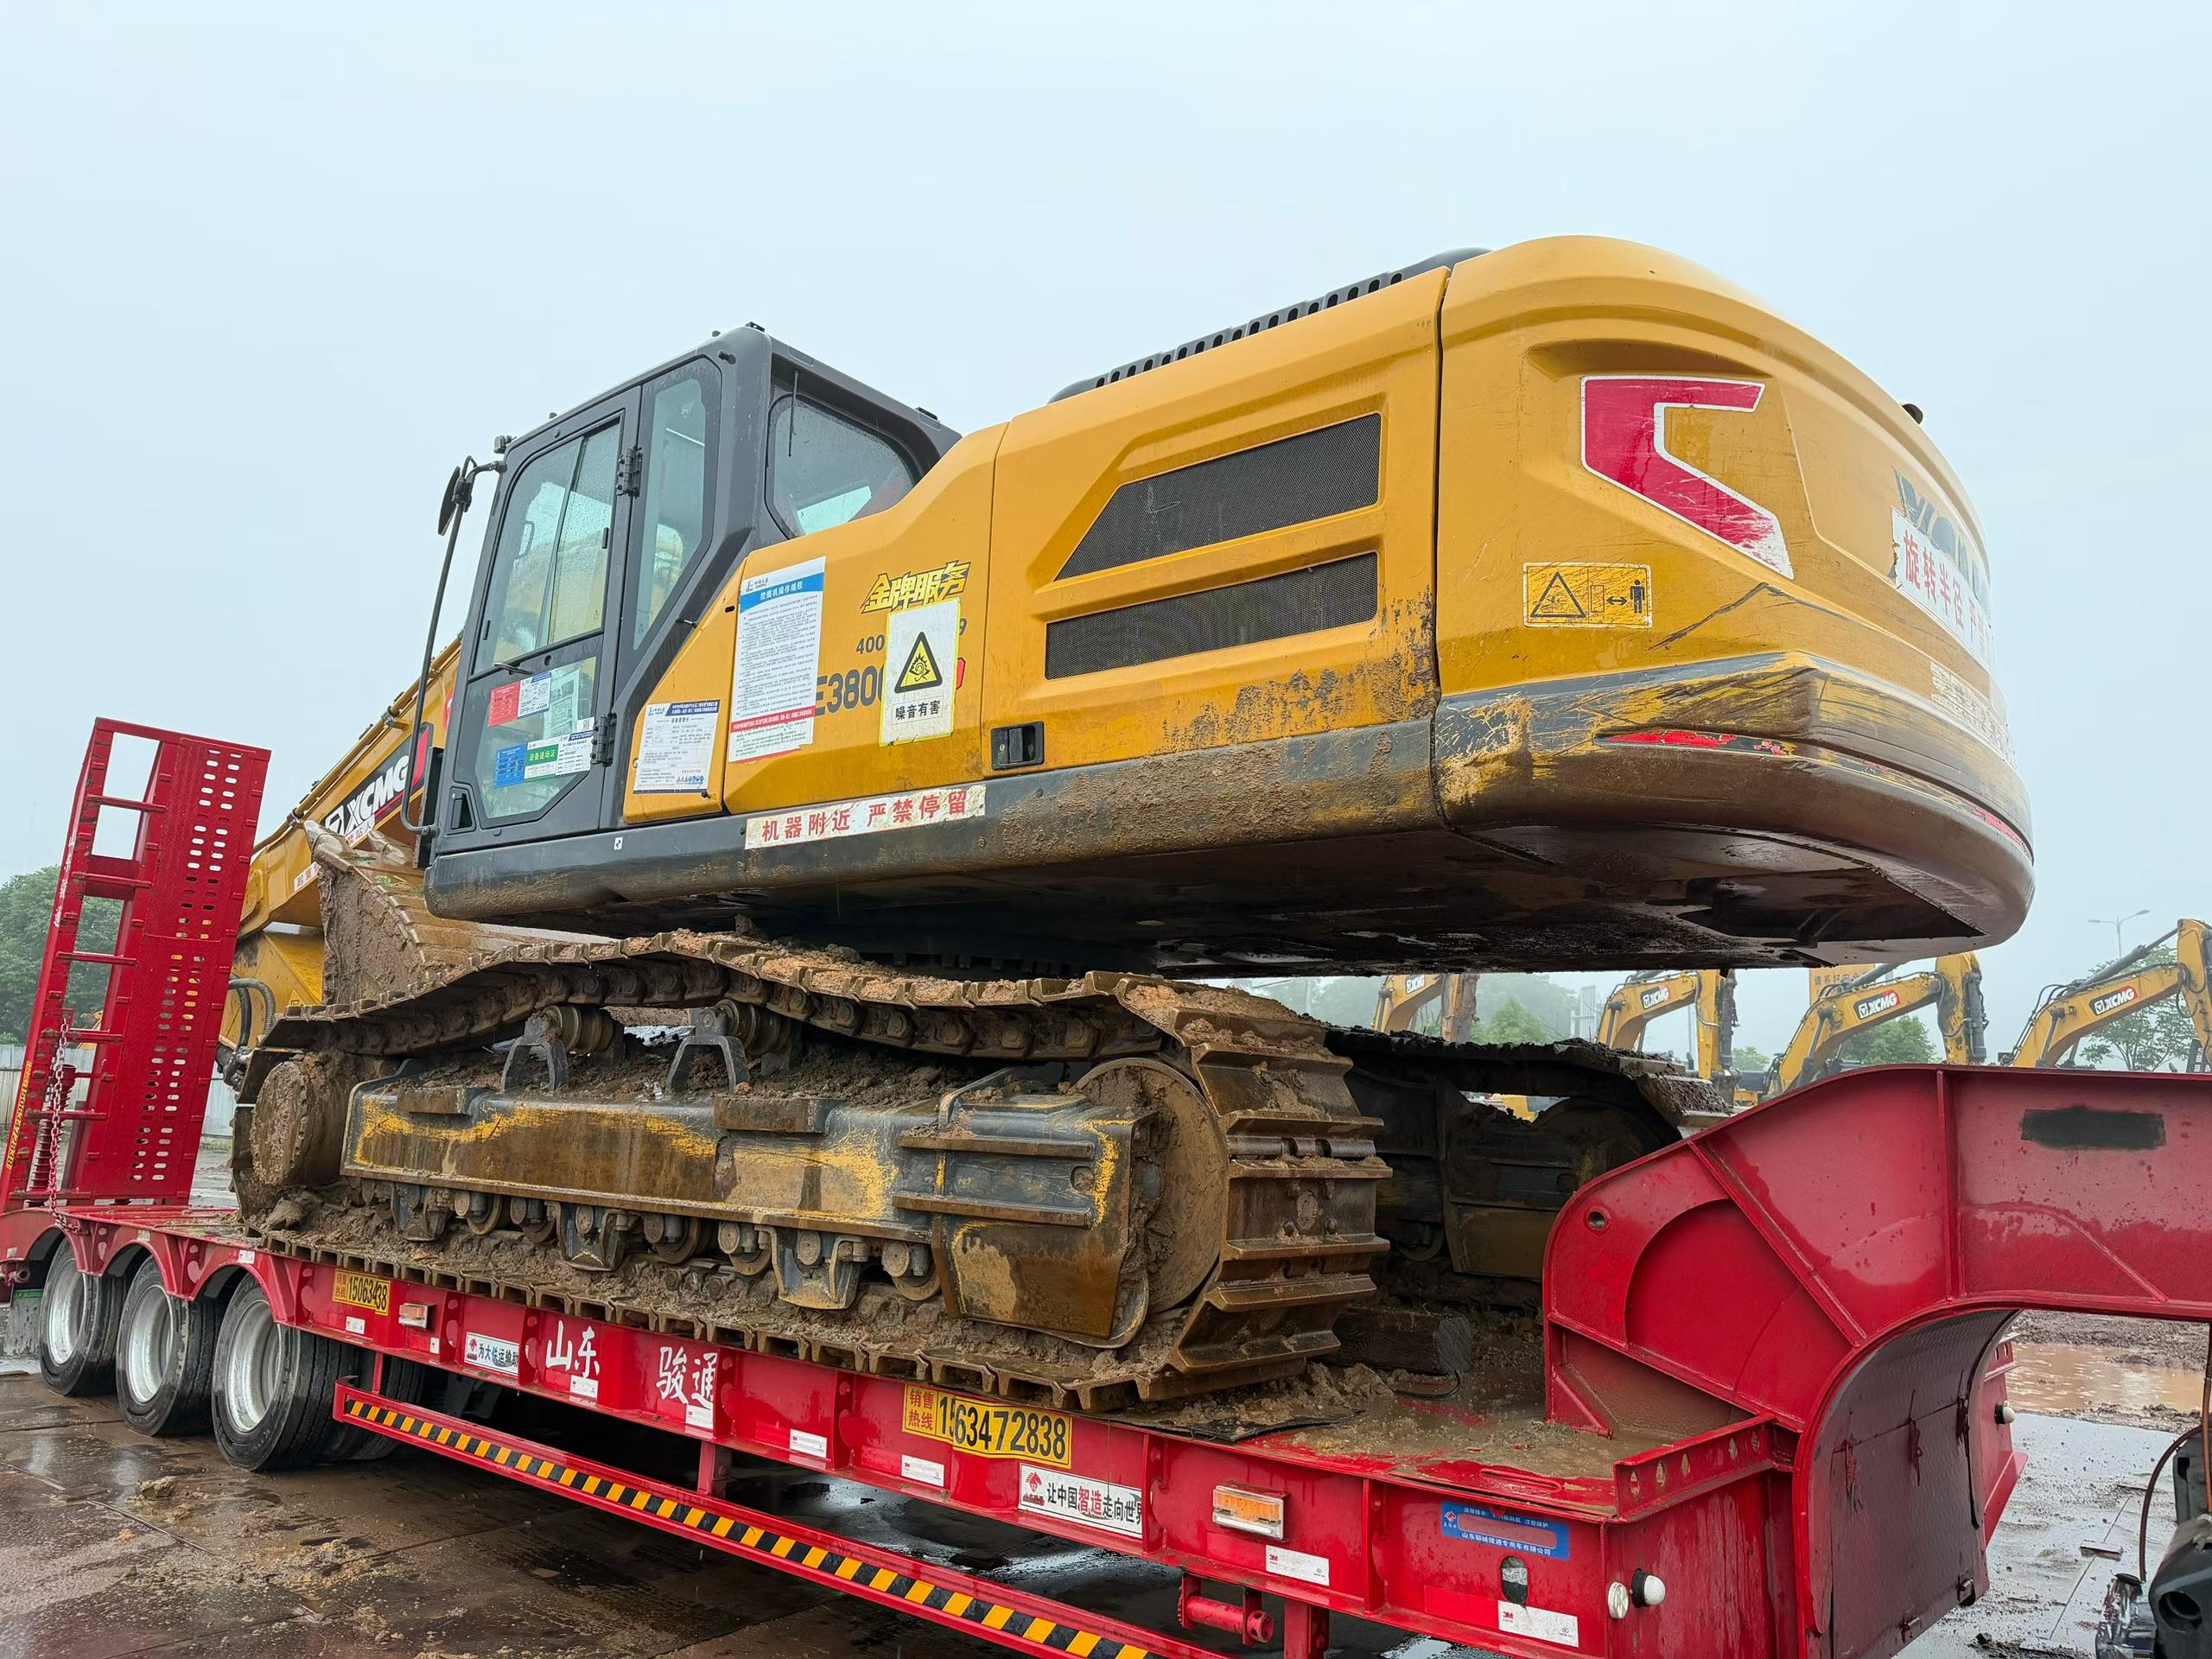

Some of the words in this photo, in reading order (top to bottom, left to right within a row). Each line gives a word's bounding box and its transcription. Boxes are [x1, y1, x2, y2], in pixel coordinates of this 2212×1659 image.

[860, 560, 972, 614] 金牌服务
[1903, 530, 1965, 630] 旋转半径
[856, 633, 885, 654] 400
[815, 663, 885, 716] E380
[895, 699, 941, 721] 噪音有害
[346, 754, 410, 835] XCMG
[761, 809, 851, 842] 机器附近
[867, 789, 968, 827] 严禁停留
[1868, 991, 1898, 1015] XCMG
[2104, 988, 2135, 1010] XCMG
[546, 1319, 601, 1380] 山东
[656, 1345, 718, 1410] 骏通
[909, 1389, 934, 1410] 销售
[908, 1409, 933, 1431] 热线
[1047, 1482, 1142, 1526] 让中国智造走向世界
[1502, 1611, 1514, 1620] 3M
